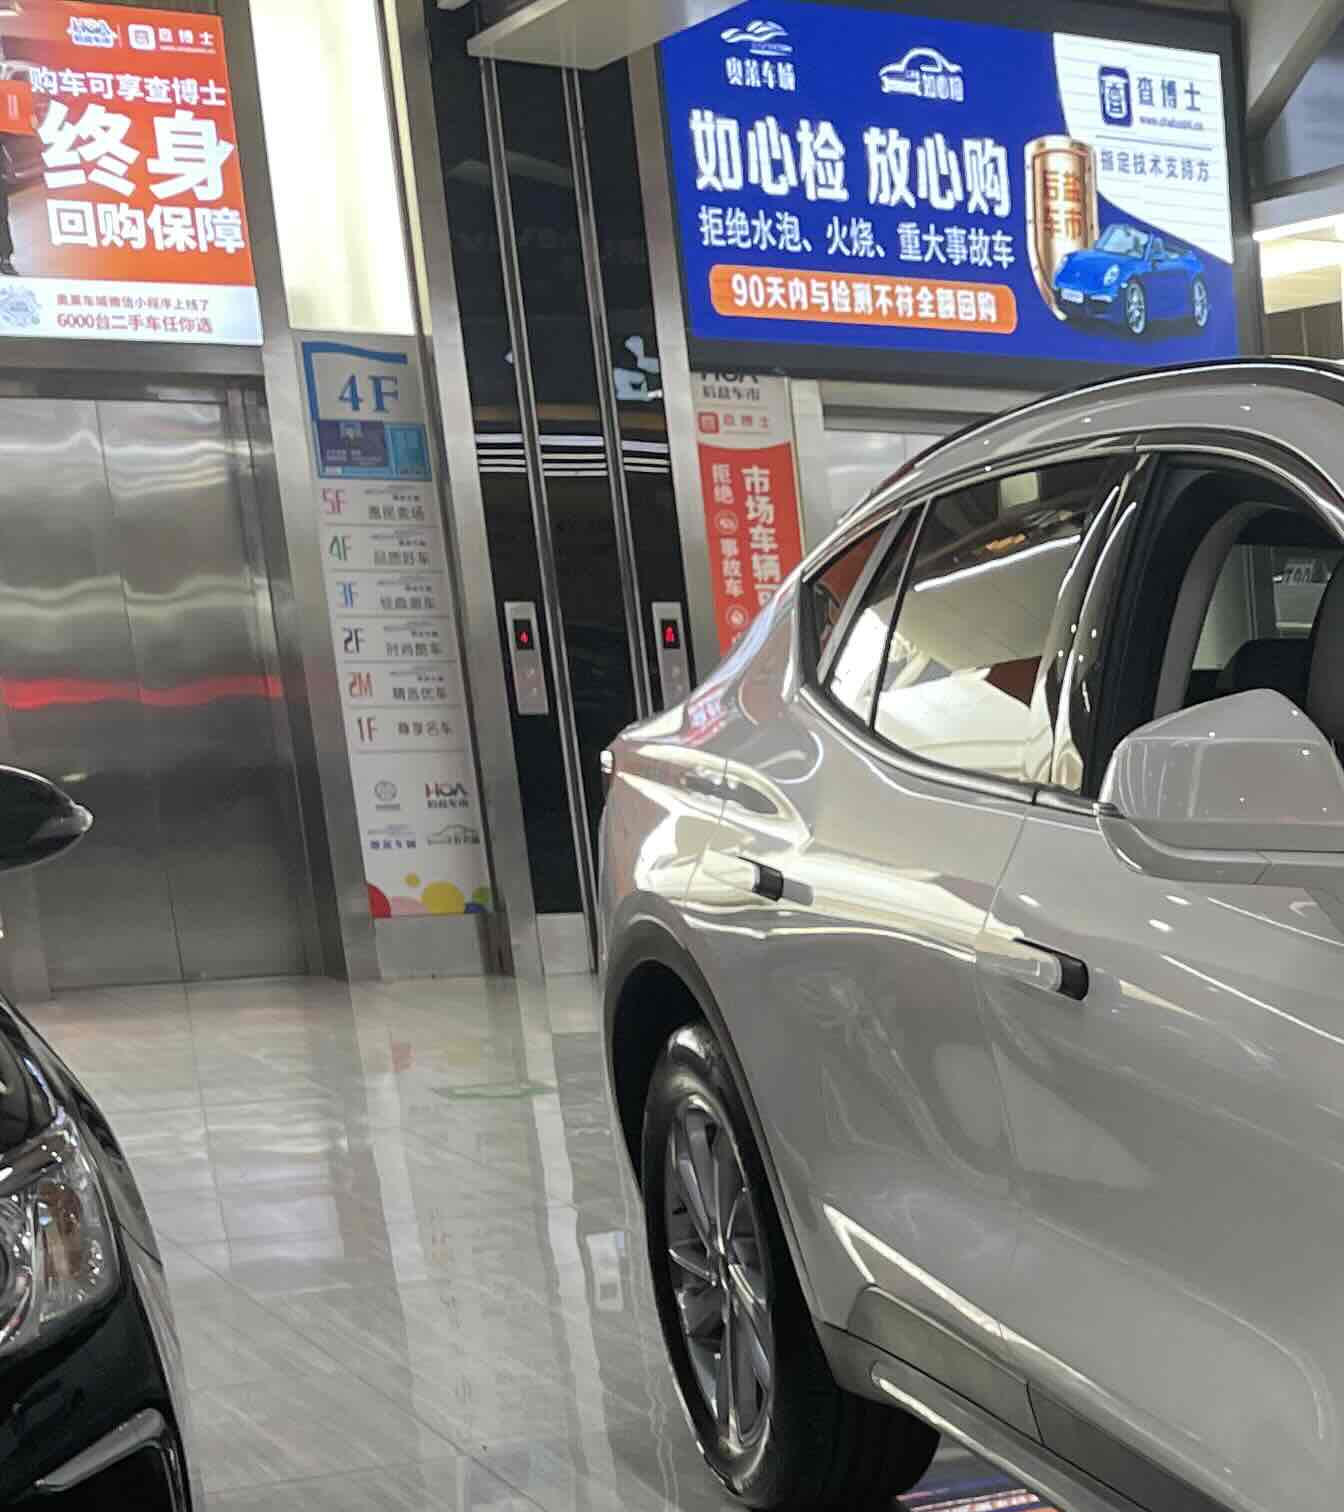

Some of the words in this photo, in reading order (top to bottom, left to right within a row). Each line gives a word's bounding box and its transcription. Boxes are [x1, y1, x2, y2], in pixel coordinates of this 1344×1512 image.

[30, 65, 227, 107] 购车可享查博士
[1137, 76, 1201, 112] 查博士
[36, 99, 236, 201] 终身
[689, 109, 850, 202] 如心检
[862, 126, 1012, 217] 放心购
[1100, 151, 1210, 183] 指定技术支持方
[47, 199, 246, 255] 回购保障
[730, 273, 998, 323] 90天内与检测不符全额回购
[56, 312, 214, 335] 6000台二手车任你选
[338, 372, 401, 414] 4F
